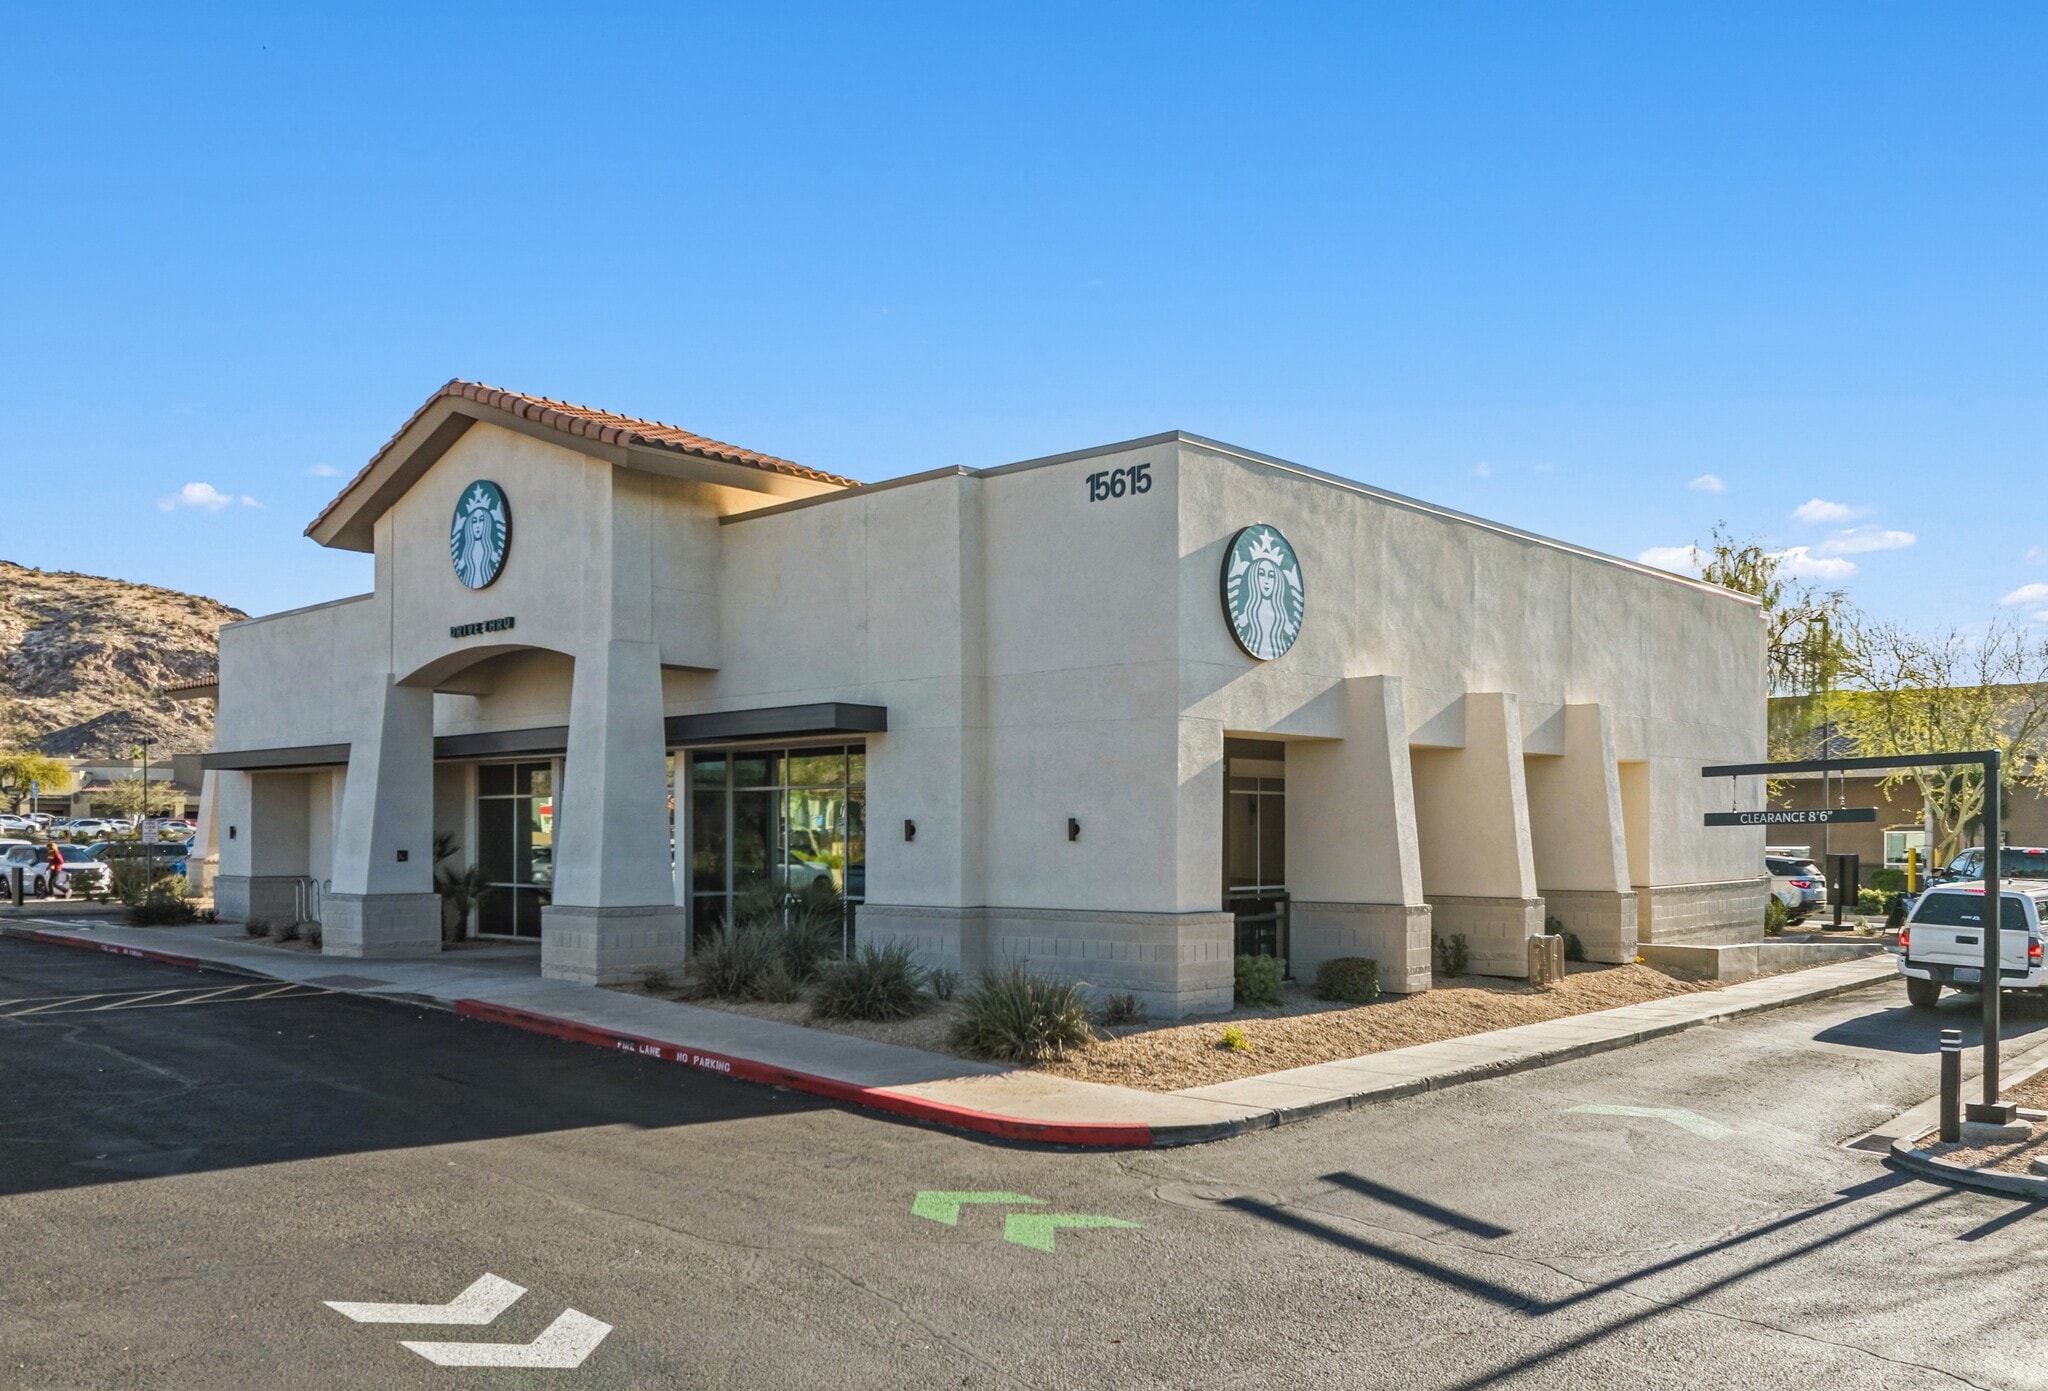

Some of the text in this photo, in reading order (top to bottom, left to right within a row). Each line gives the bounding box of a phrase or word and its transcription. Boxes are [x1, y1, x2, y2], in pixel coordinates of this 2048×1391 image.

[1086, 463, 1152, 502] 15615
[450, 617, 515, 638] DRIVE THRU
[1740, 811, 1833, 824] CLEARANCE 8'6"
[639, 1045, 661, 1058] LANE
[676, 1052, 688, 1063] NO
[693, 1056, 731, 1072] PARKING
